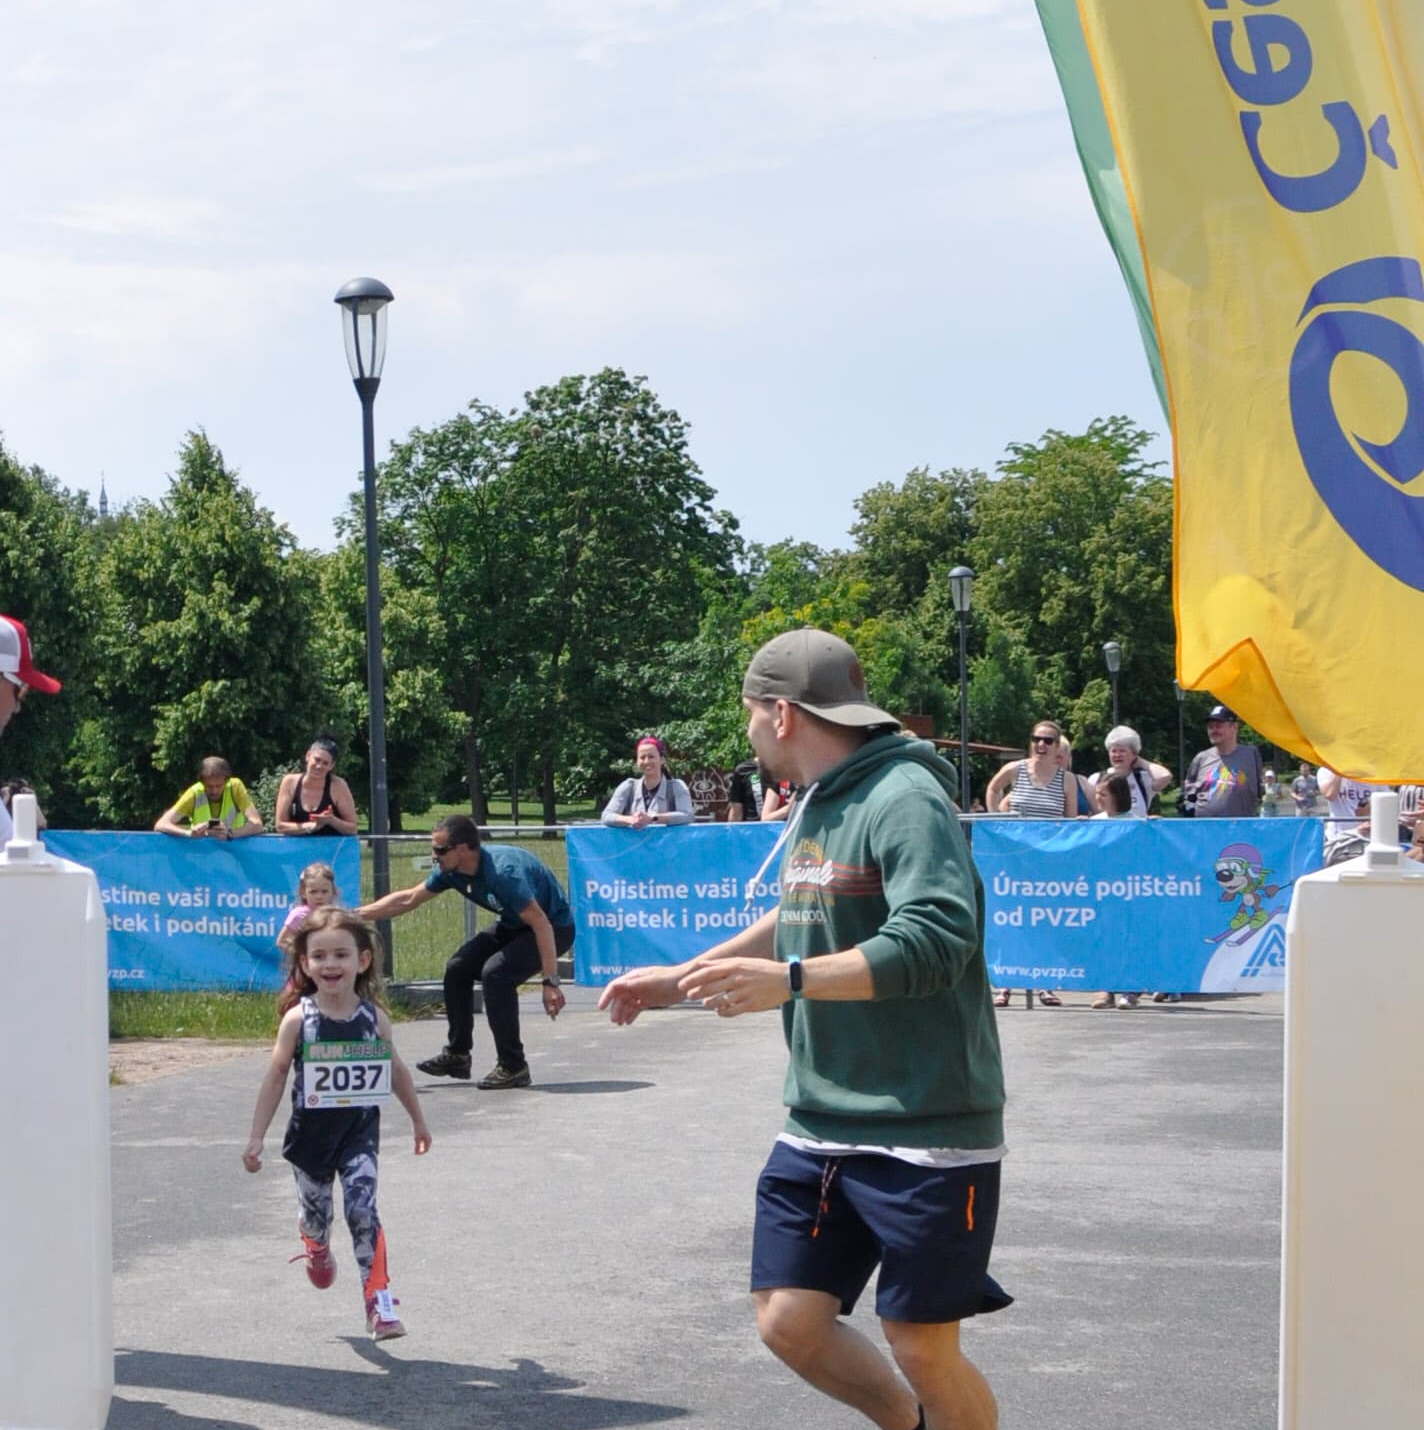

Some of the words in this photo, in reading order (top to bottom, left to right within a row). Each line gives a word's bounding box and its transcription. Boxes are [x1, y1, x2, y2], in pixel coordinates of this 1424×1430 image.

[101, 885, 160, 905] stíme
[167, 888, 210, 907] vaši
[586, 879, 689, 903] Pojistíme
[694, 878, 737, 899] vaši
[993, 871, 1089, 897] Úrazové
[1096, 875, 1202, 901] pojištění
[154, 915, 160, 932] i
[167, 916, 274, 937] podnikání
[588, 908, 675, 931] majetek
[682, 909, 688, 927] i
[695, 907, 764, 931] podni
[993, 905, 1023, 927] od
[1031, 907, 1096, 927] PVZP
[993, 965, 1085, 979] www.pvzp.cz
[314, 1065, 383, 1091] 2037
